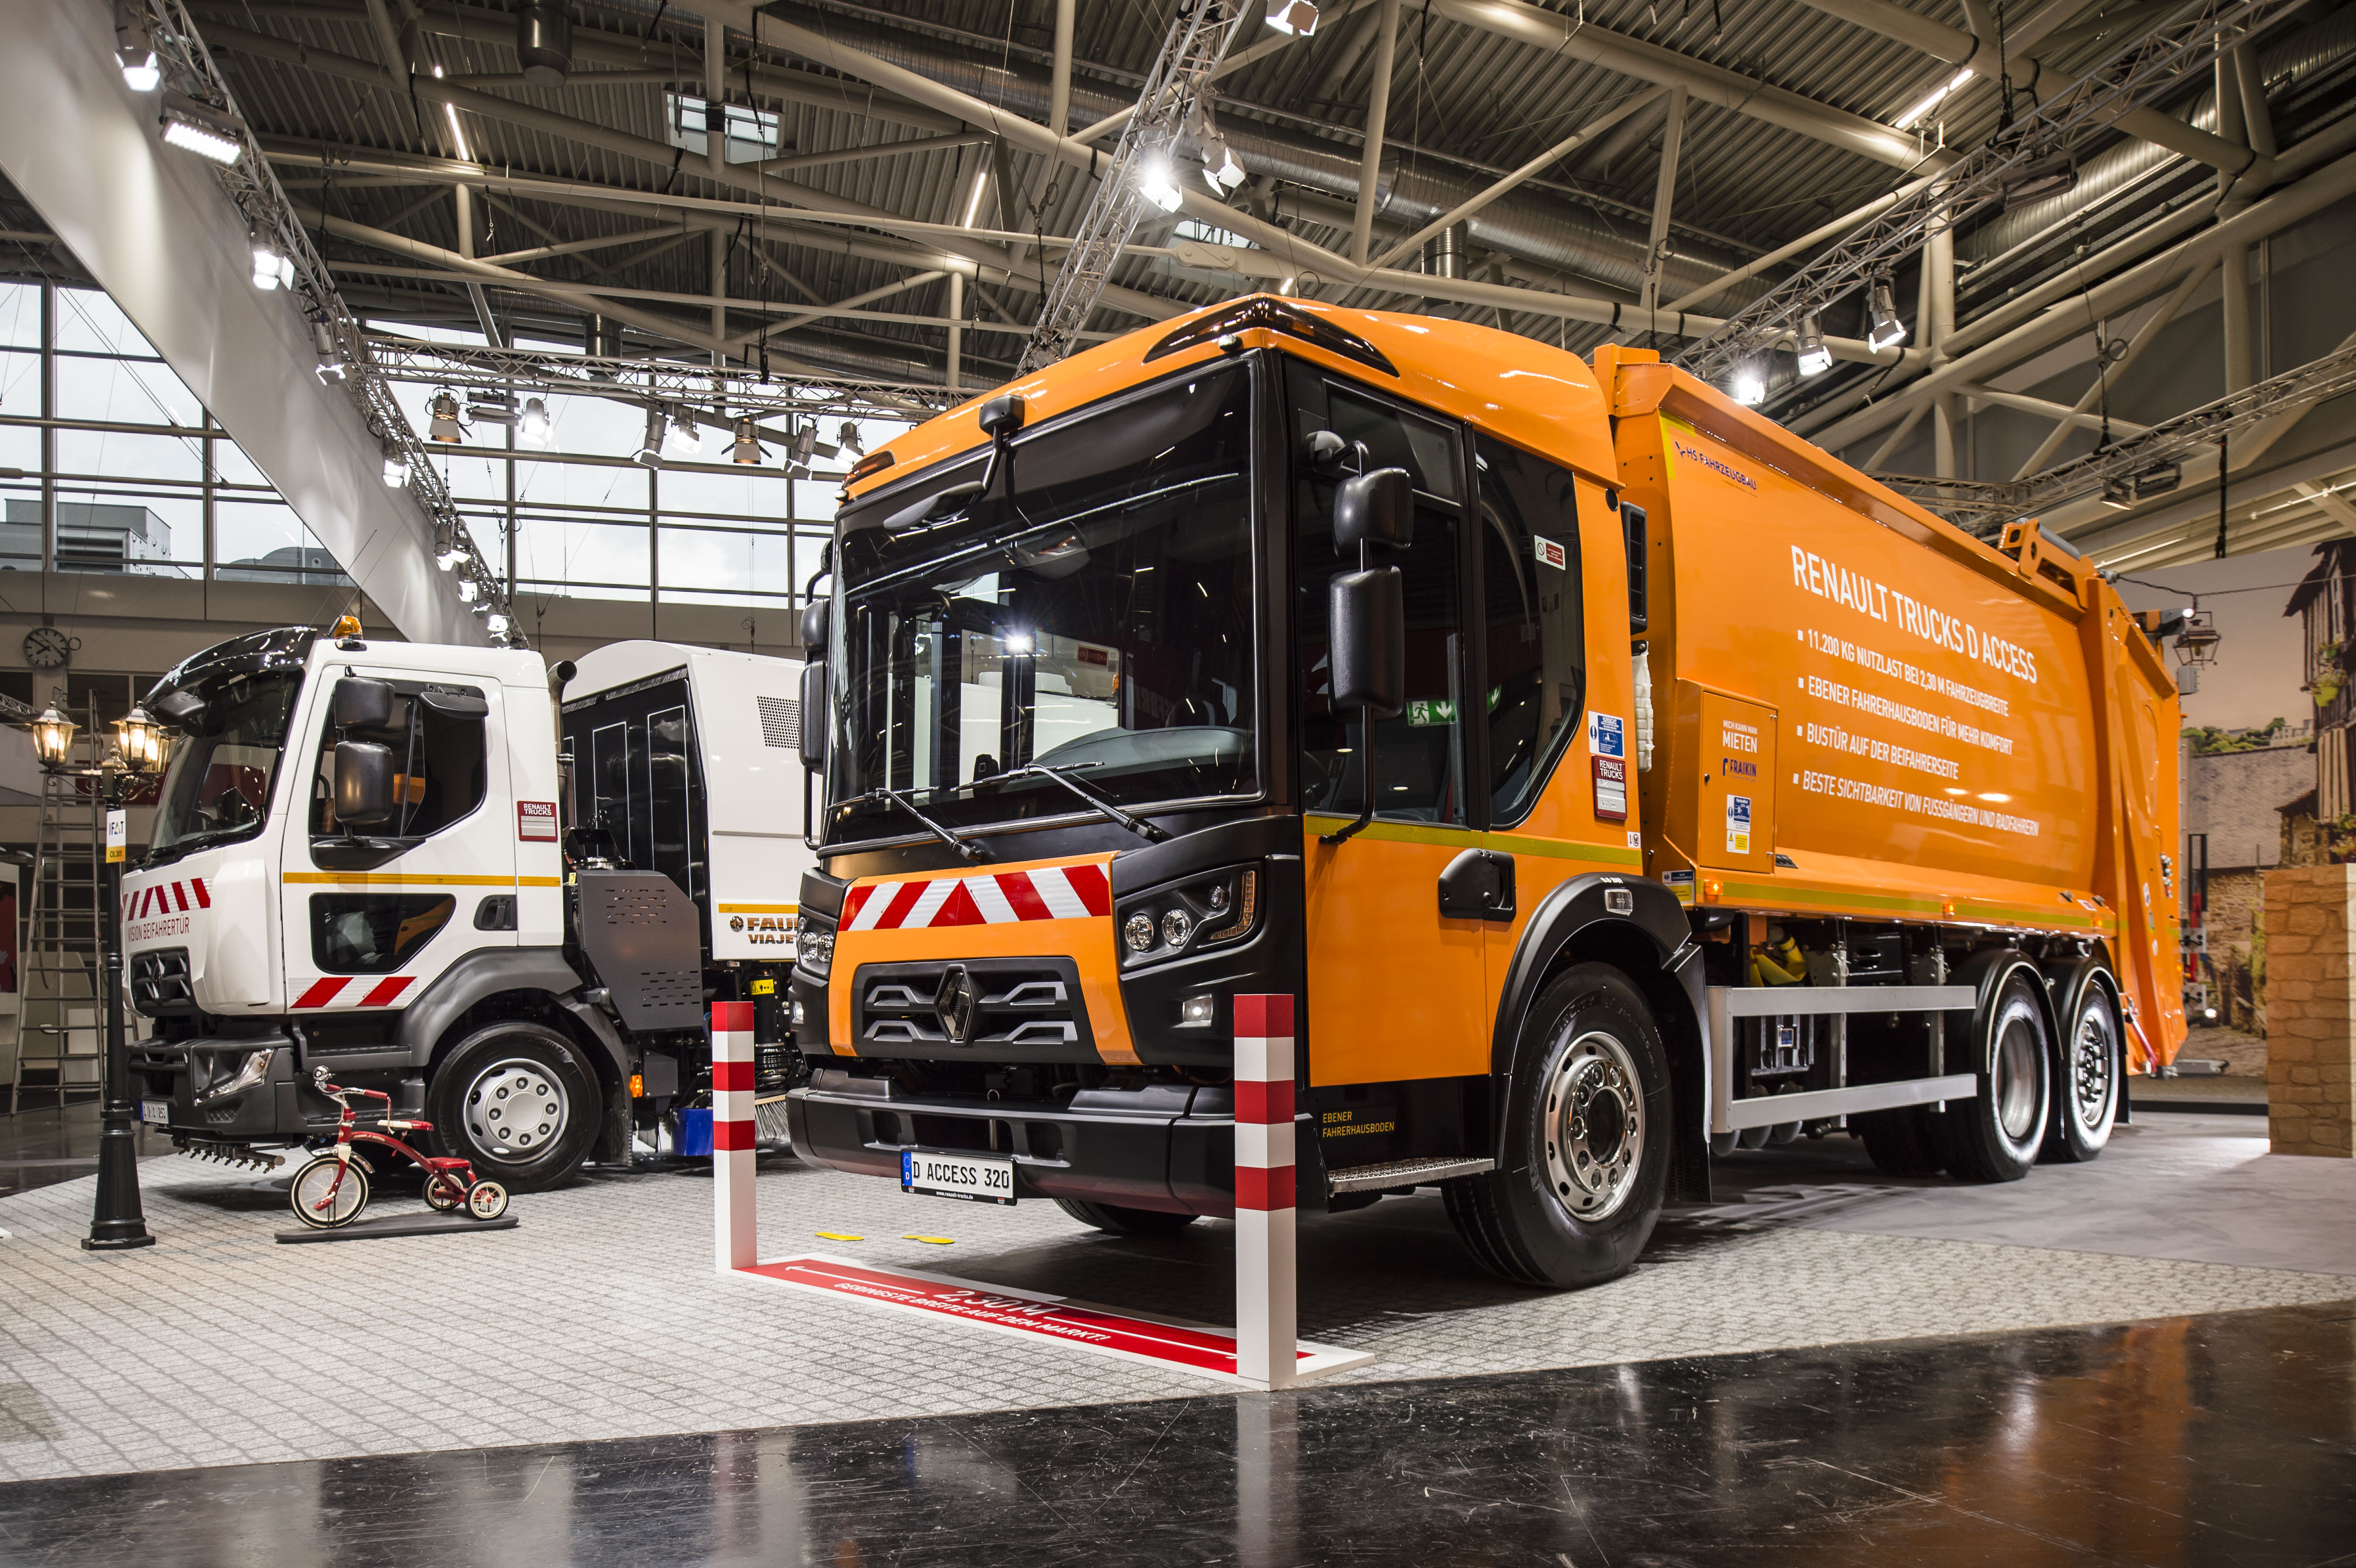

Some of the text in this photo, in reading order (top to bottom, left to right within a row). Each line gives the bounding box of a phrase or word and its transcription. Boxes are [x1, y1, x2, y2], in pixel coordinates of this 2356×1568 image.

[1686, 446, 1697, 461] HS
[1700, 453, 1757, 490] FAHRZEUGBAU
[1791, 545, 2037, 684] RENAULT TRUCKS D ACCESS
[1808, 629, 2009, 717] 11.200 KG NUTZLAST BEI 2,30 M FAHRZEUGBREITE
[1808, 675, 2013, 755] EBENER FAHRERHAUSBODEN FÜR MEHR KOMFORT
[1723, 719, 1758, 735] MICH KANN MAN
[1723, 730, 1758, 753] MIETEN
[1807, 722, 1959, 780] BUSTÜR AUF DER BEIFAHRERSEITE
[1599, 759, 1622, 769] RENAULT
[1600, 768, 1623, 780] TRUCKS
[1730, 759, 1757, 777] FRAIKIN
[1802, 770, 2039, 837] BESTE SICHTBARKEIT VON FUSSGÄNGERN UND RADFAHRERN
[109, 821, 123, 835] IFAT
[128, 913, 189, 941] VISION BEIFAHRERTÜR
[748, 934, 797, 944] VIAJE
[1323, 1111, 1352, 1123] EBENER
[1323, 1122, 1394, 1138] FAHRERHAUSBODEN
[905, 1172, 910, 1180] D
[913, 1161, 1009, 1189] D ACCESS 320
[936, 1191, 973, 1200] www.renault-trucks.de
[834, 1282, 1111, 1341] GERINGSTE BREITE AUF DEM MARKT!
[933, 1290, 1062, 1316] 2,30 M
